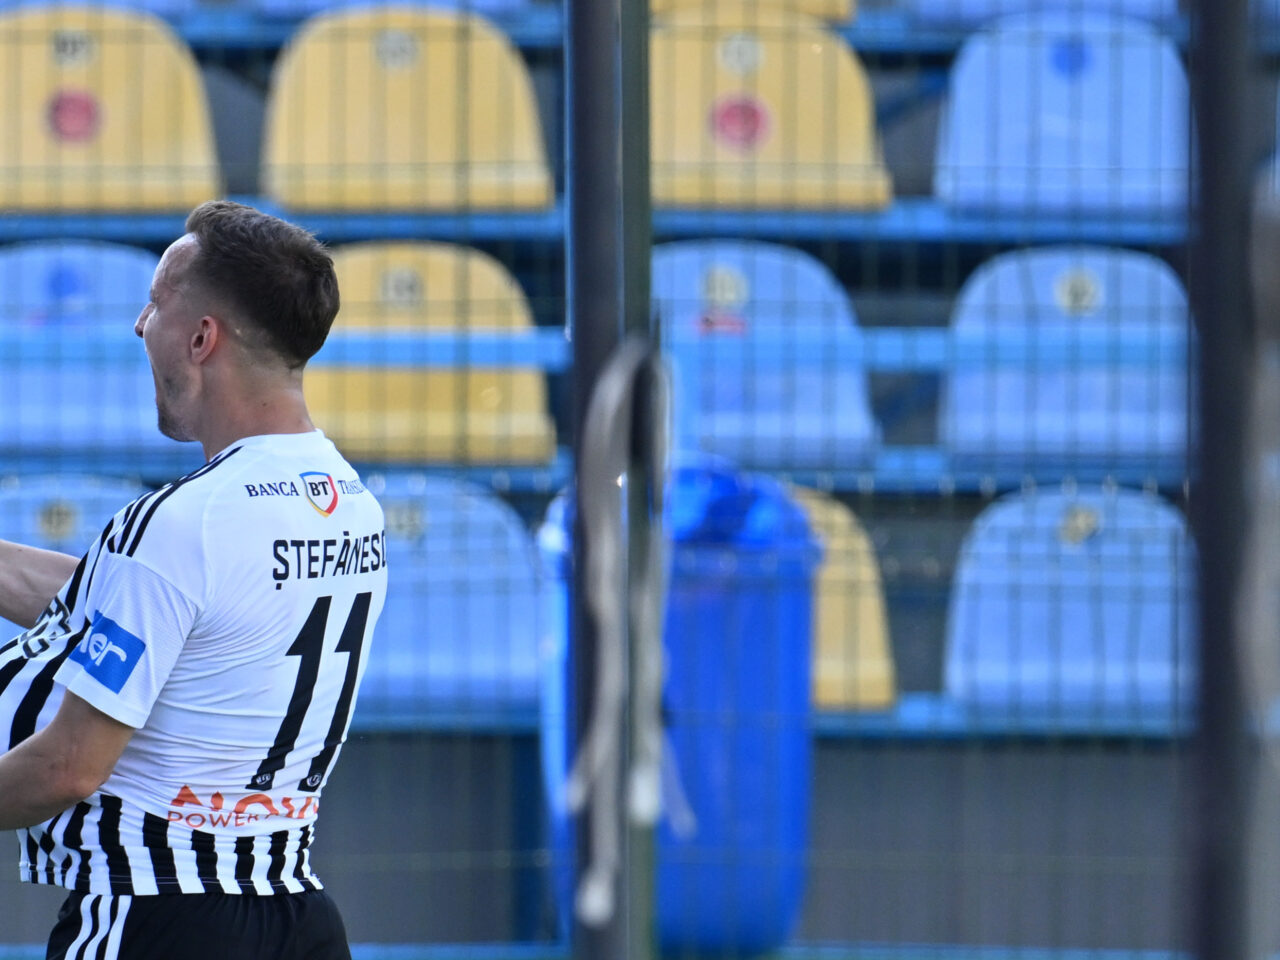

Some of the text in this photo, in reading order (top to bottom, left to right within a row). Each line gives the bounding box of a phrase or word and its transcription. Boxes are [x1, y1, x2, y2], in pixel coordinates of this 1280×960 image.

[244, 481, 300, 497] BANCA
[308, 481, 329, 496] BT
[246, 591, 372, 791] 11
